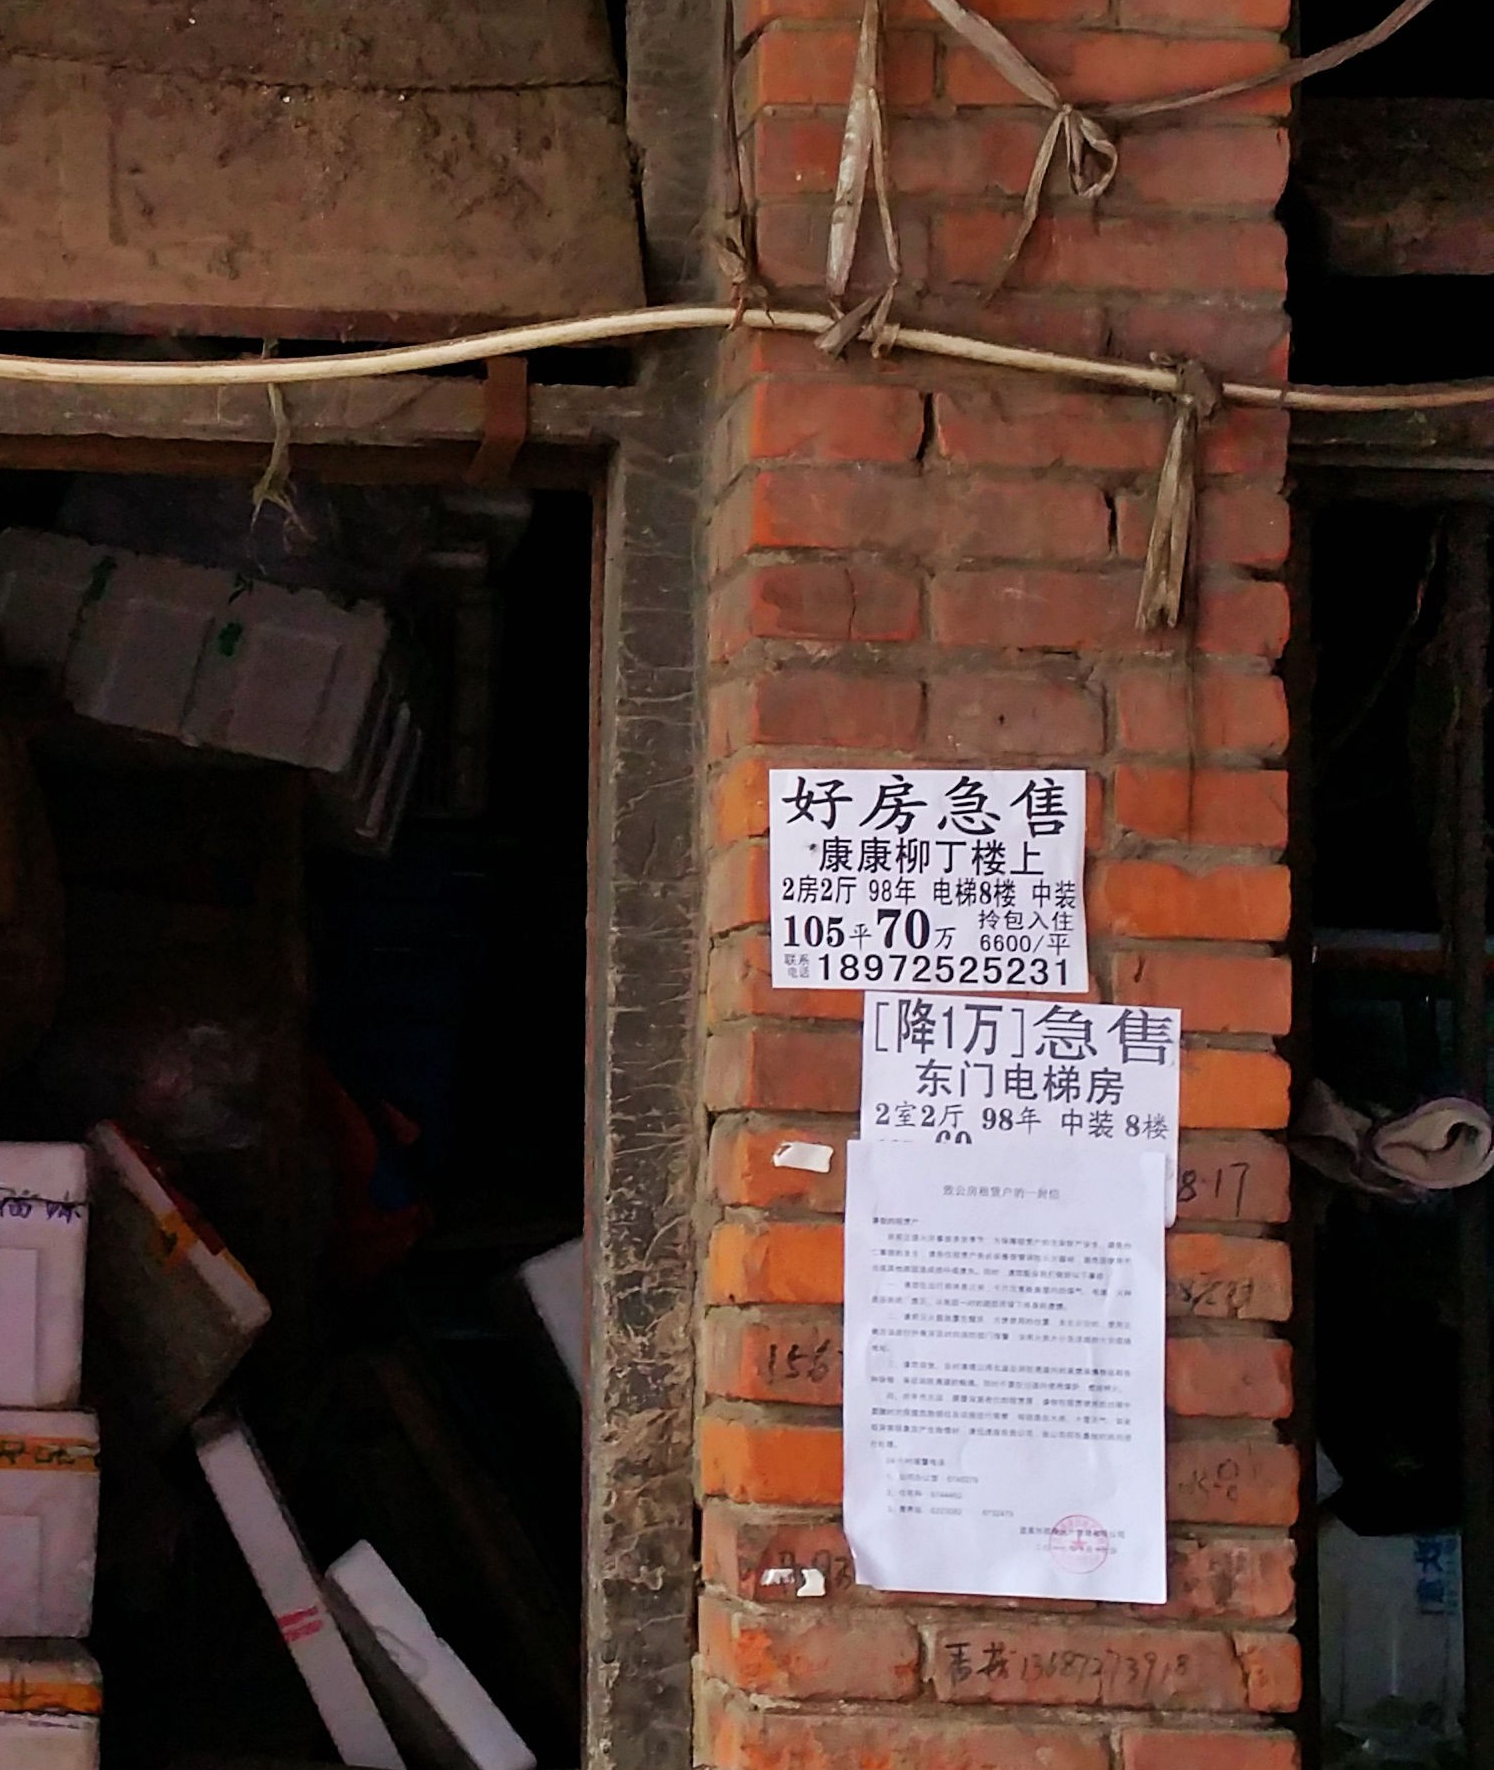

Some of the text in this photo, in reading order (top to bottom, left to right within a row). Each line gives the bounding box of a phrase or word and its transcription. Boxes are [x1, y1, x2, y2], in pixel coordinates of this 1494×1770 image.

[782, 774, 1068, 839] 好房急售
[819, 836, 1045, 876] 康康柳丁楼上
[782, 877, 1077, 910] 2房2厅 98年 电梯8楼 中装
[978, 909, 1074, 932] 拎包入住
[979, 933, 1071, 956] 6600/平
[818, 954, 1068, 986] 18972525231
[874, 998, 1175, 1067] [降1万]急售
[915, 1058, 1125, 1106] 东门电梯房
[875, 1100, 1170, 1141] 2室2厅 98年 中装 8楼
